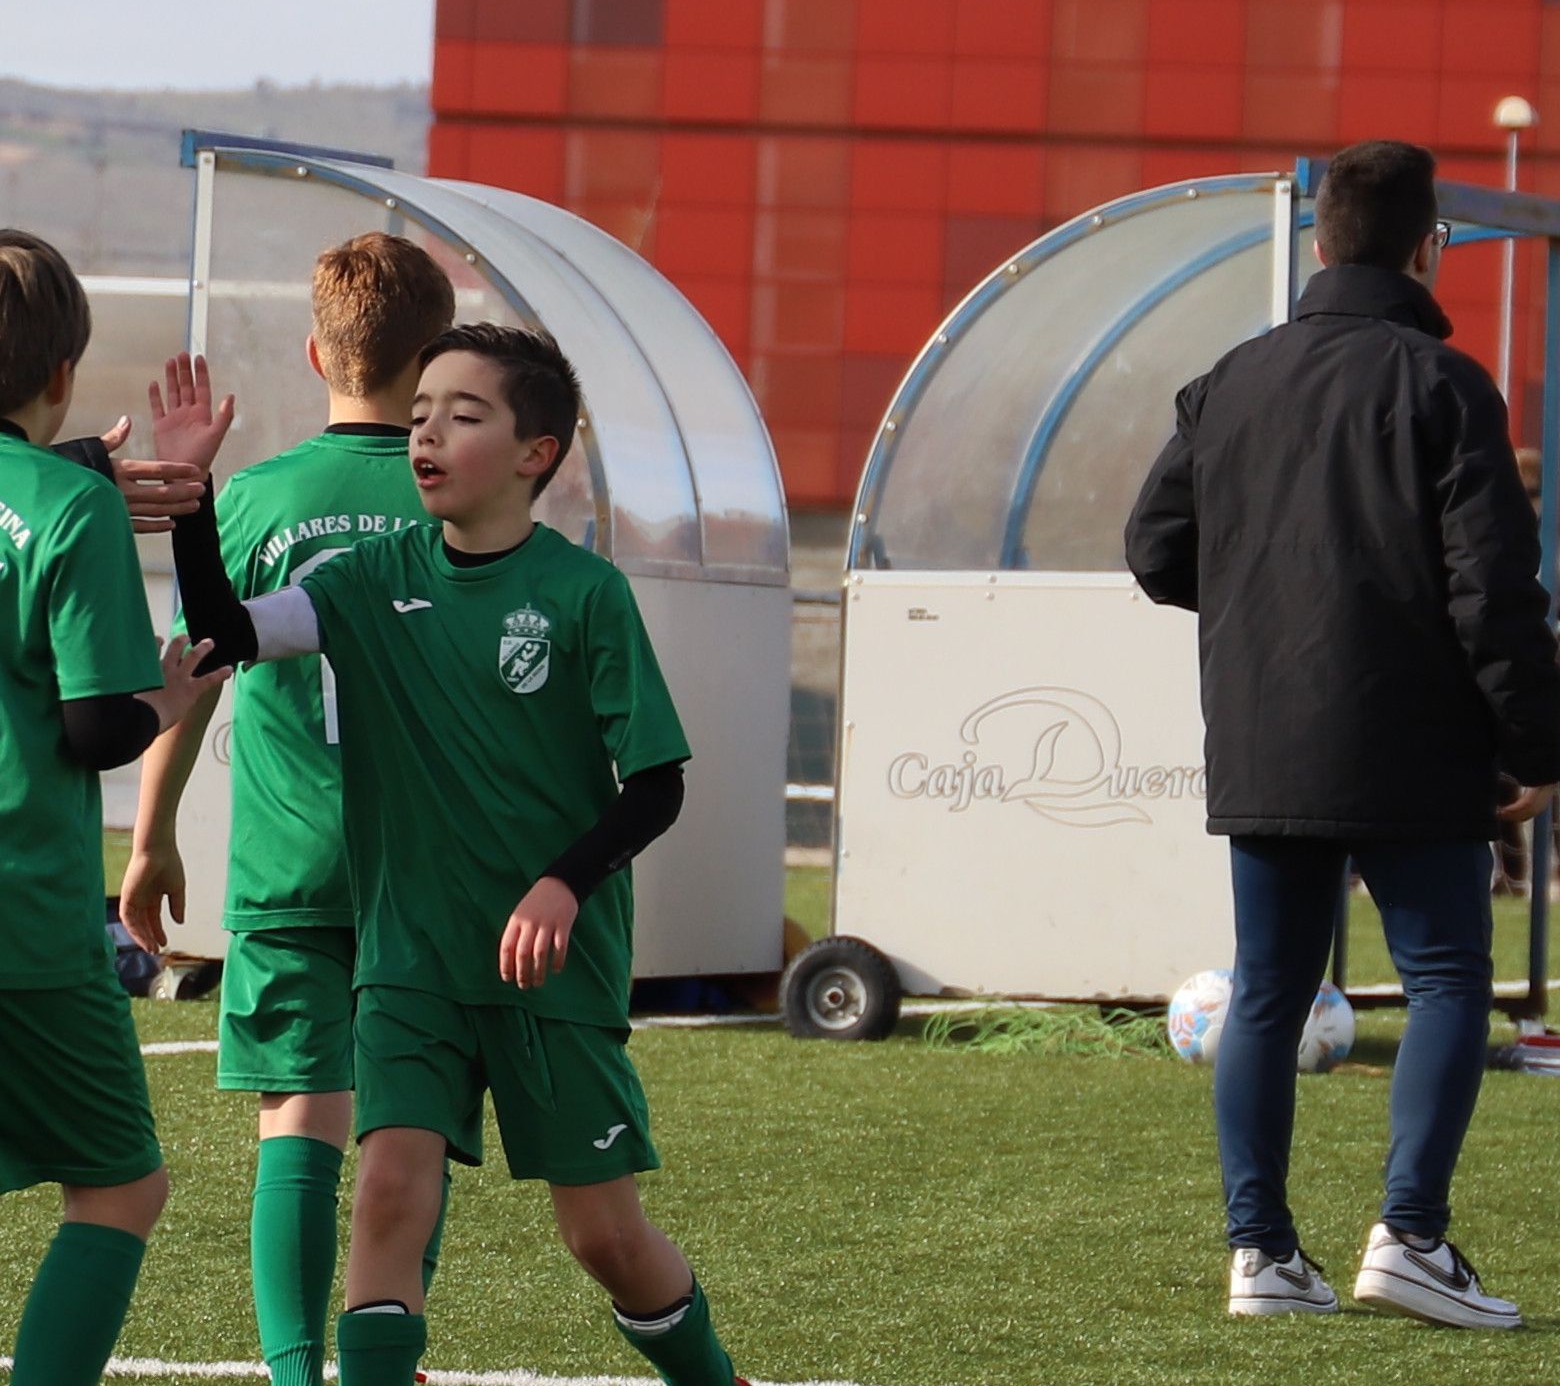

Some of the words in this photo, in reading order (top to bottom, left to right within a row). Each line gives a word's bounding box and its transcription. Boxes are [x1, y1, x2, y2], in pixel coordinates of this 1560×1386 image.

[258, 515, 351, 567] VILLARES
[358, 515, 386, 533] DE
[888, 751, 1005, 812] Caja
